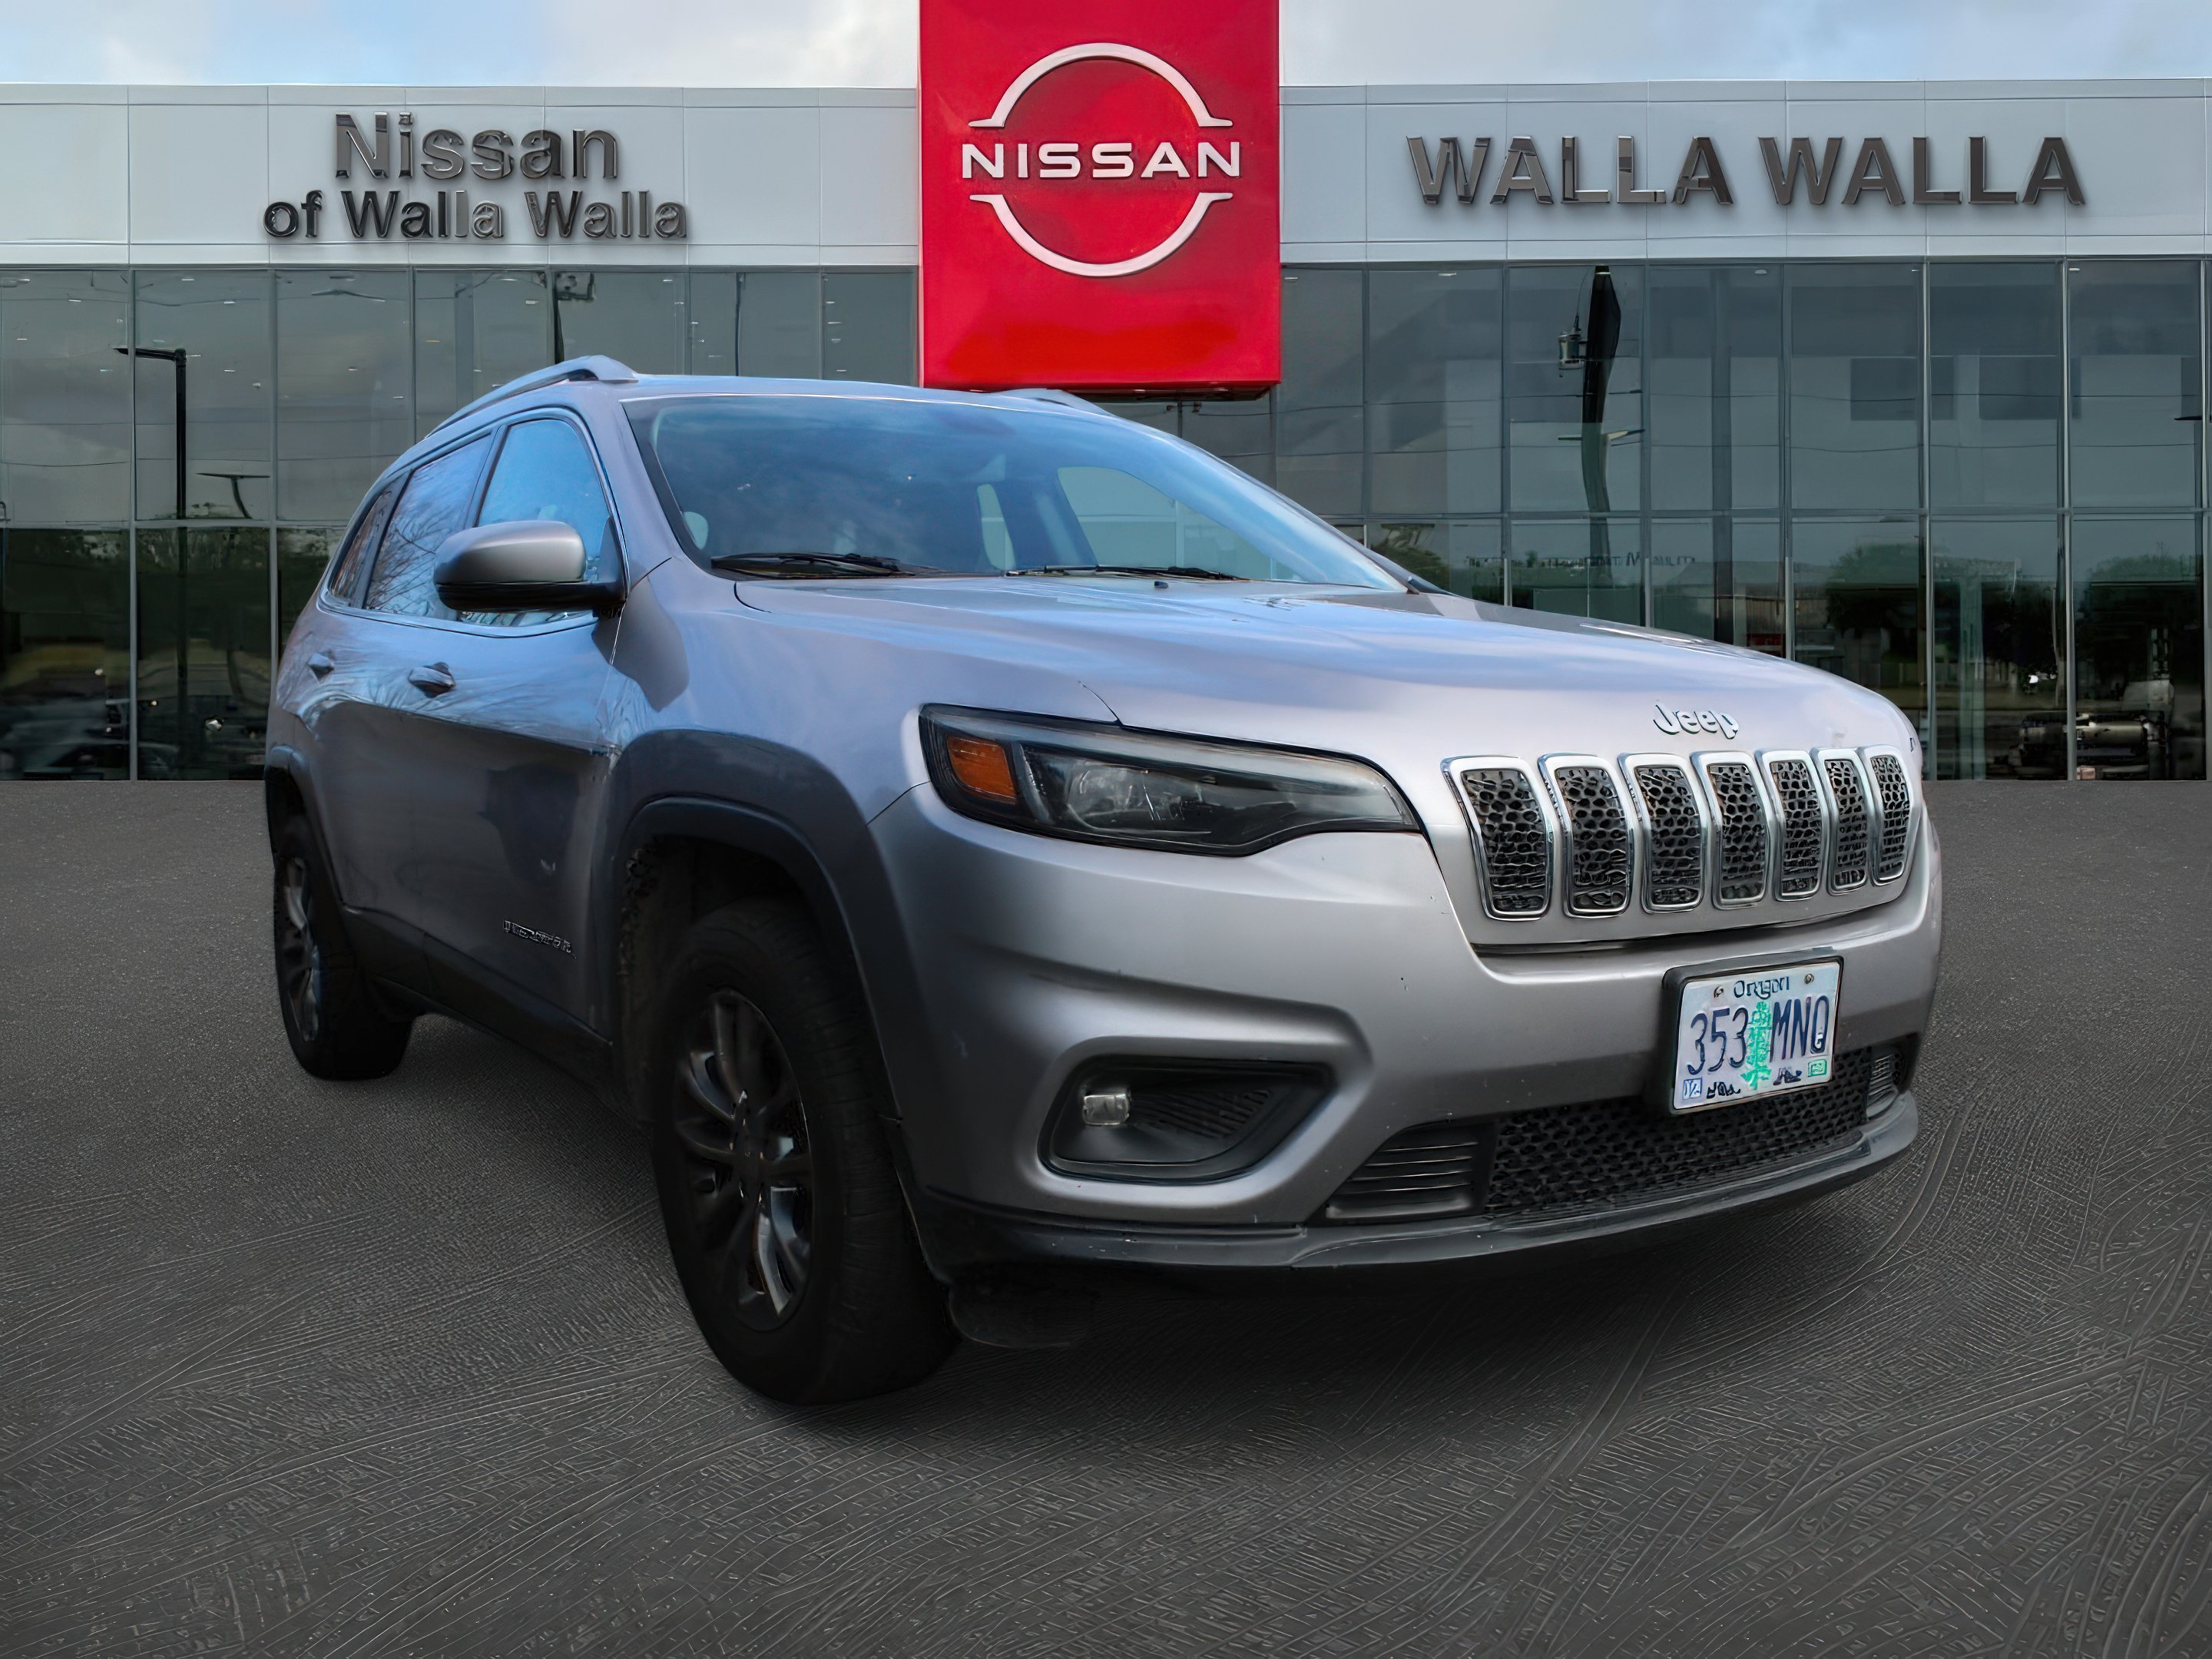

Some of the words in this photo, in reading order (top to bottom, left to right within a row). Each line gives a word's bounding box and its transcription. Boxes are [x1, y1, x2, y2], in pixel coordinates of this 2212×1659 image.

[335, 111, 618, 180] Nissan
[961, 141, 1241, 180] NISSAN
[1406, 135, 1734, 206] WALLA
[1757, 136, 2086, 206] WALLA
[263, 189, 324, 239] of
[339, 190, 505, 239] Walla
[523, 190, 688, 239] Walla
[1653, 703, 1740, 740] Jeep
